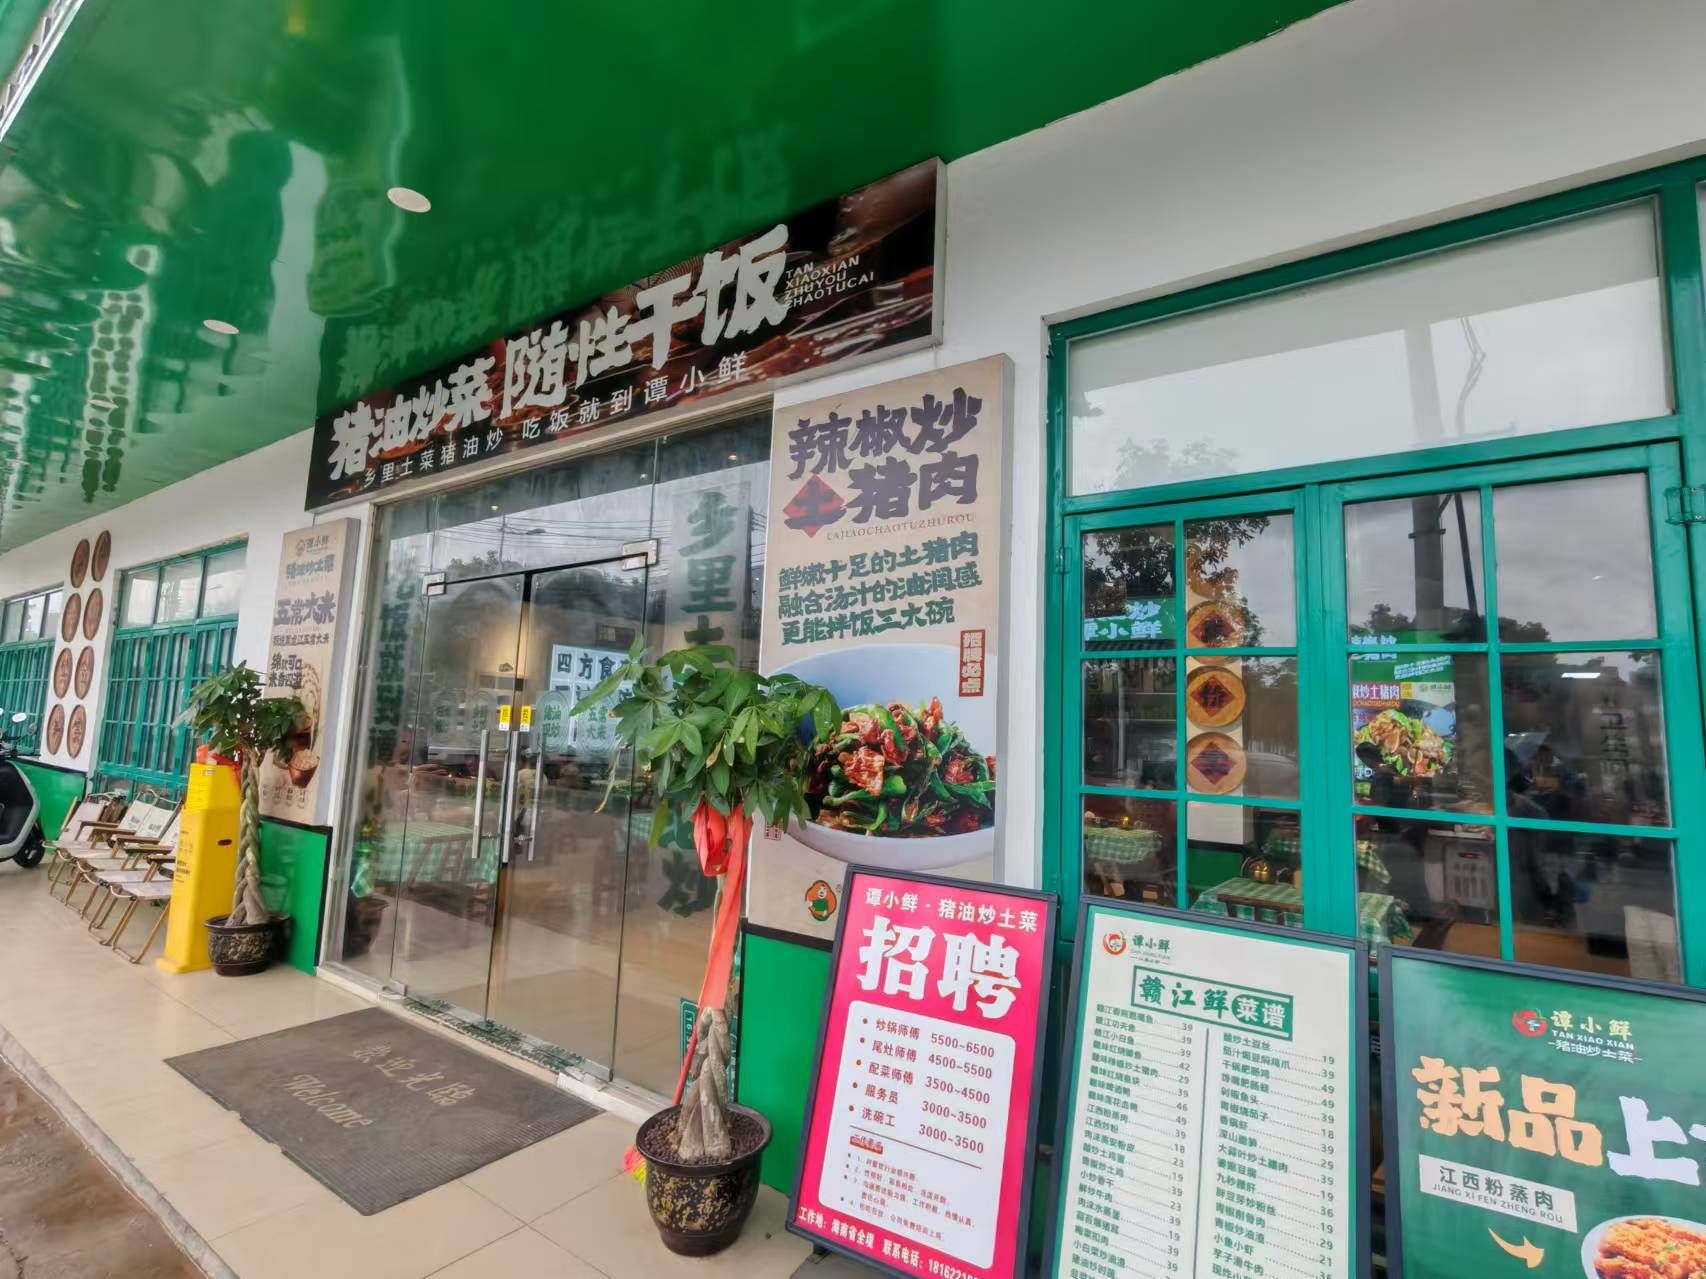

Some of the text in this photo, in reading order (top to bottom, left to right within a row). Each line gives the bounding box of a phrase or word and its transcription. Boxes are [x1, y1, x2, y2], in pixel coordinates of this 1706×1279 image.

[785, 255, 859, 289] XIAOXIAN
[786, 262, 814, 279] TAN
[784, 270, 847, 300] ZHUYOU
[327, 223, 790, 480] 猪油炒菜 随性干饭
[363, 351, 748, 489] 乡里土菜猪油炒 吃饭就到谭小鲜
[787, 387, 983, 480] 辣椒炒
[784, 450, 979, 530] 土猪肉
[778, 530, 979, 592] 鲜嫩十足的土猪肉
[778, 561, 983, 619] 融合汤汁的油润感
[273, 591, 336, 625] 五常大米
[781, 596, 956, 646] 更能拌饭三大碗
[557, 653, 629, 681] 四方食
[857, 915, 1022, 1019] 招聘
[876, 1018, 920, 1040] 炒锅师傅
[1551, 1010, 1632, 1041] 谭小鲜
[1551, 1030, 1634, 1050] TAN XIAO XIAN
[872, 1040, 917, 1063] 尾灶师傅
[1180, 1048, 1191, 1058] 39
[1322, 1056, 1335, 1065] 19
[1556, 1040, 1634, 1064] 猪油炒土菜
[868, 1061, 914, 1085] 配菜师傅
[1179, 1062, 1190, 1071] 42
[1321, 1069, 1334, 1079] 39
[865, 1084, 899, 1104] 服务员
[1321, 1084, 1334, 1094] 49
[284, 1074, 373, 1129] Welcome
[1321, 1099, 1334, 1109] 49
[862, 1107, 896, 1128] 洗碗工
[1321, 1113, 1334, 1124] 39
[1175, 1129, 1186, 1139] 39
[1322, 1129, 1334, 1139] 18
[1321, 1143, 1334, 1155] 39
[1320, 1159, 1334, 1170] 29
[1172, 1172, 1184, 1182] 19
[1320, 1175, 1334, 1186] 39
[1320, 1191, 1334, 1202] 19
[1440, 1166, 1553, 1210] 江西粉蒸肉
[1320, 1206, 1334, 1217] 36
[1432, 1184, 1563, 1224] JIANG XI FEN ZHENG ROU
[1169, 1215, 1181, 1226] 39
[1320, 1222, 1333, 1234] 19
[1167, 1245, 1179, 1257] 39
[1320, 1238, 1333, 1250] 29
[1320, 1254, 1332, 1267] 21
